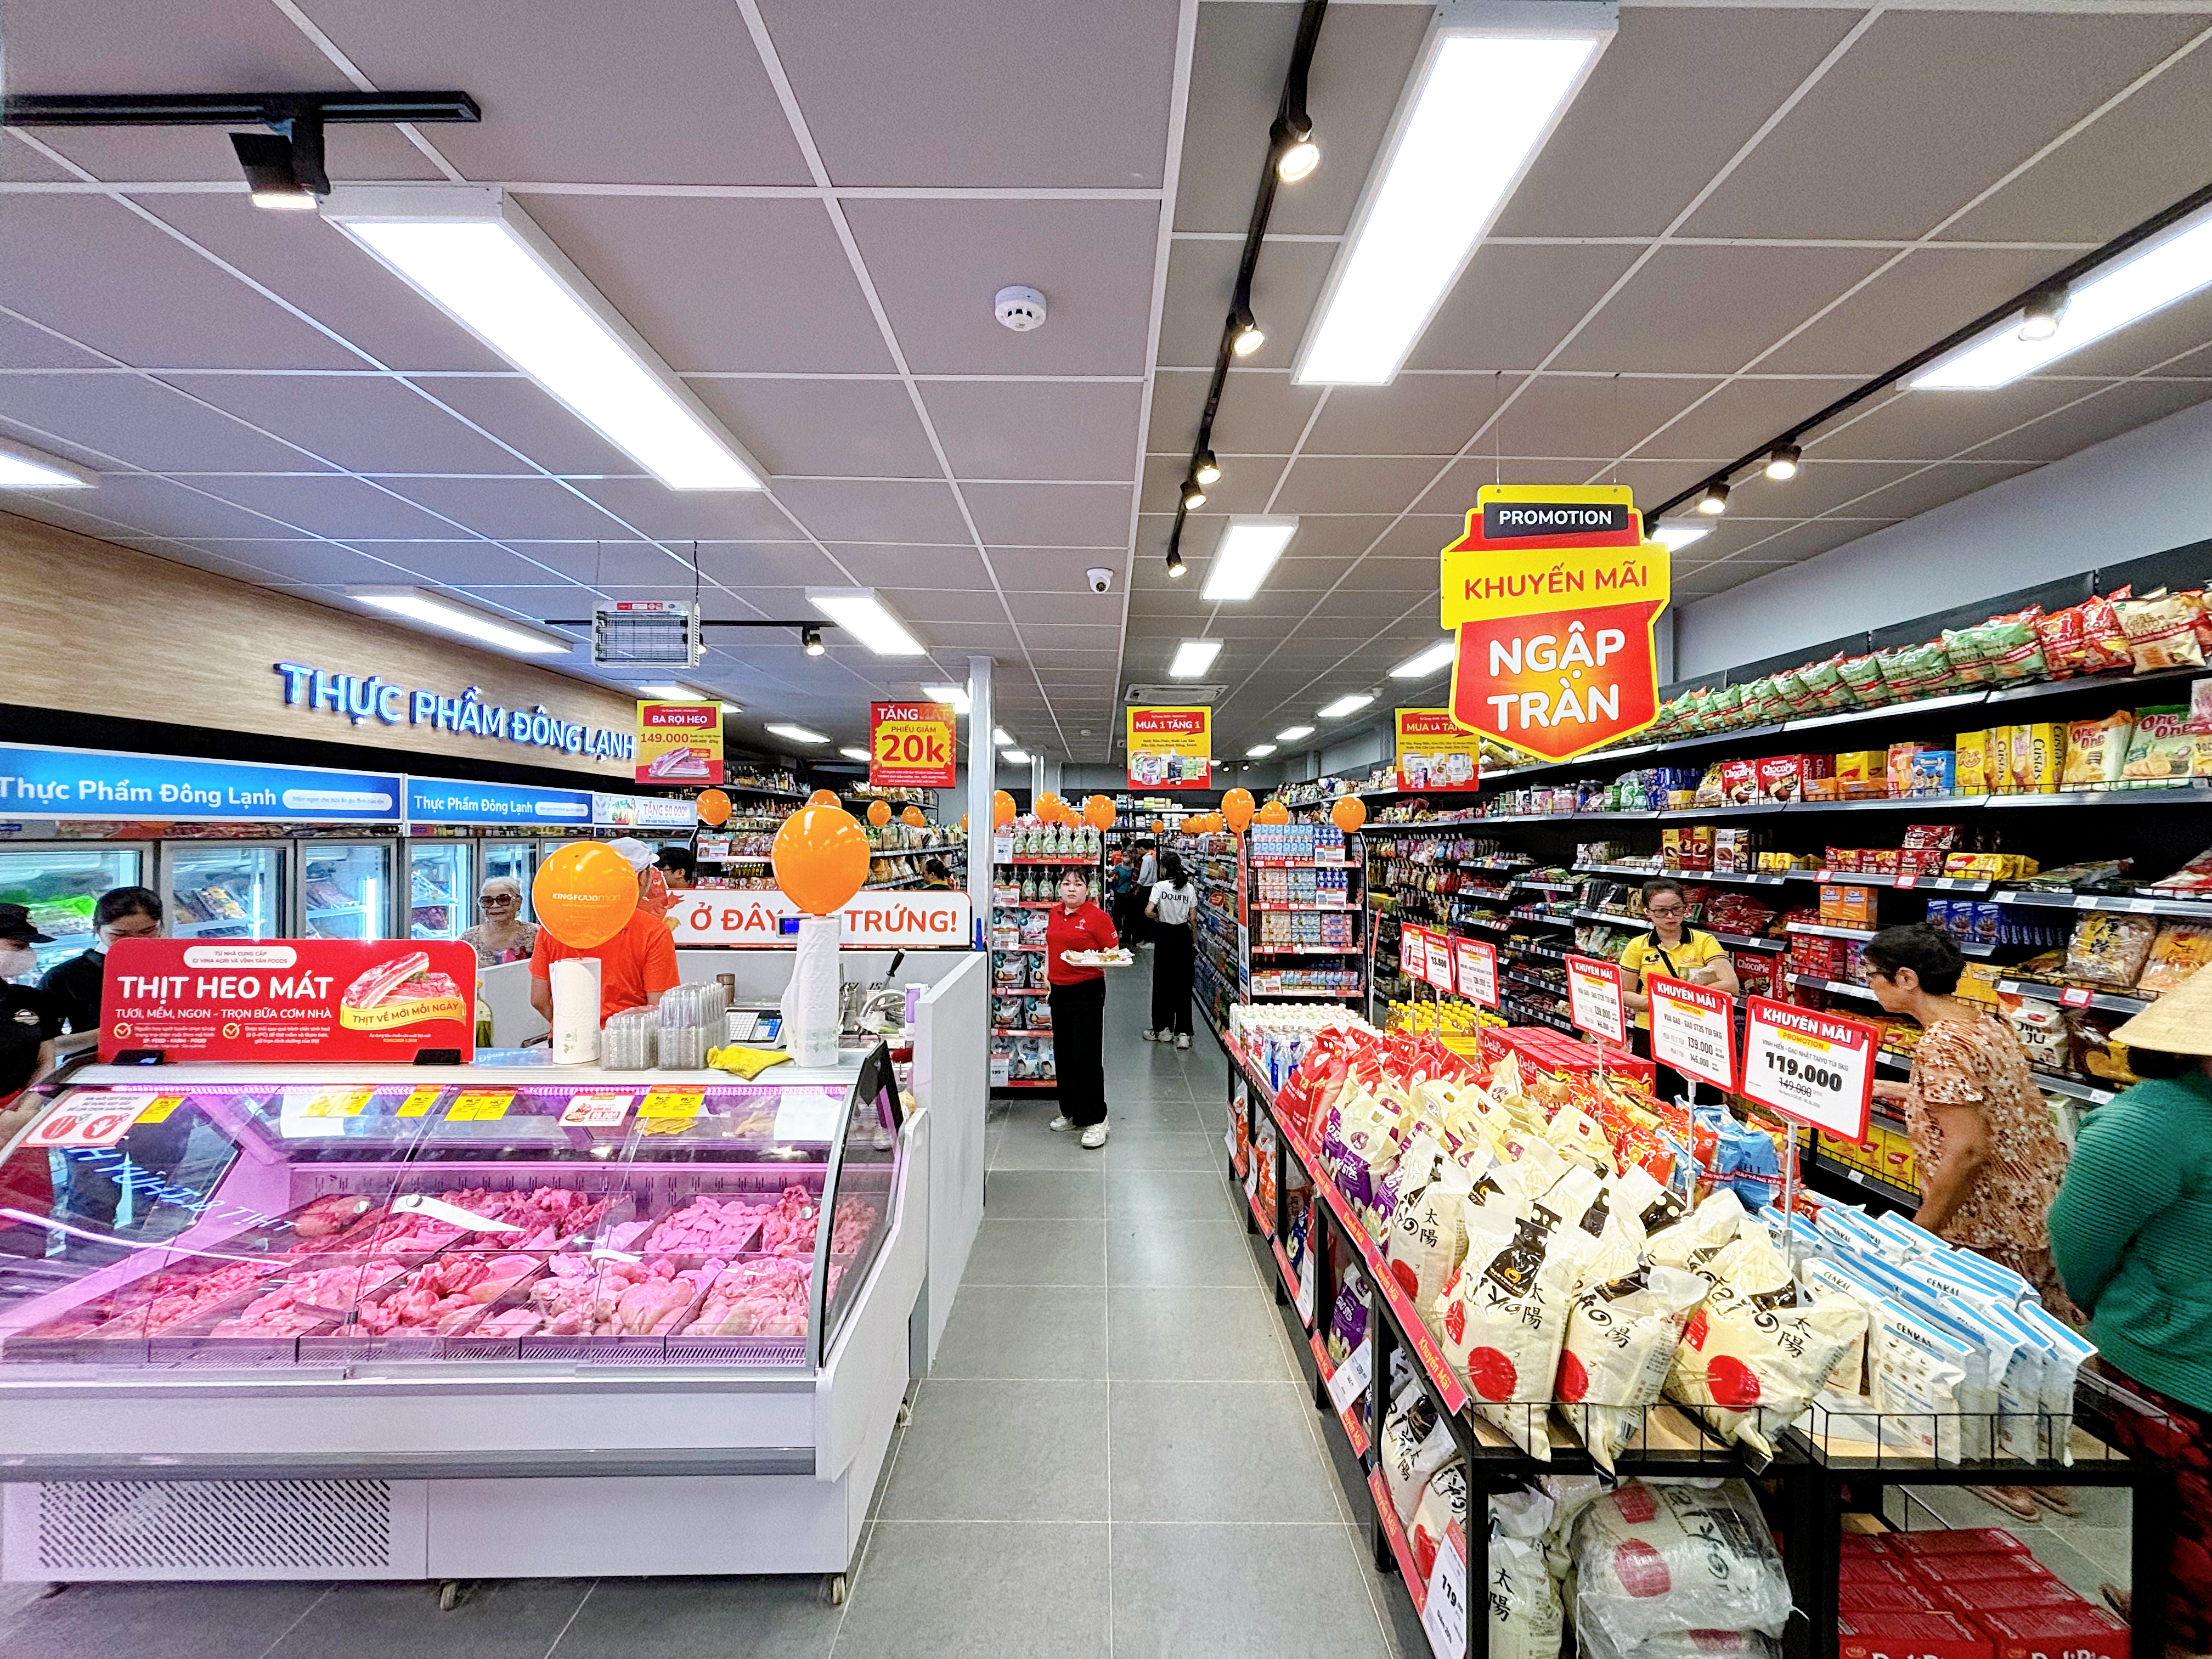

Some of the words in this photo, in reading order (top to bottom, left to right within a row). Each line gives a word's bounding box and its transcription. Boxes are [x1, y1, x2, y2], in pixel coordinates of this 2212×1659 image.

[1499, 510, 1612, 526] PROMOTION
[1465, 562, 1584, 600] KHUYẾN
[1595, 560, 1647, 591] MÃI
[1489, 620, 1625, 679] NGẬP
[273, 663, 404, 725] THỰC
[410, 686, 506, 737] PHẨM
[508, 704, 583, 752] ĐÔNG
[583, 726, 636, 762] LẠNH
[1487, 676, 1620, 731] TRÀN
[652, 715, 666, 724] BA
[668, 715, 685, 725] RỌI
[687, 715, 708, 724] HEO
[891, 724, 914, 733] PHIẾU
[916, 725, 936, 733] GIẢM
[1136, 721, 1158, 729] MUA
[1166, 719, 1193, 731] TẶNG
[1195, 720, 1200, 729] 1
[1407, 723, 1429, 731] MUA
[2141, 714, 2178, 732] One
[640, 733, 689, 743] 149.000
[882, 734, 944, 763] 20k
[1997, 740, 2006, 781] Custas
[2033, 738, 2045, 780] Custas
[1724, 766, 1756, 778] ChocoPie
[1762, 764, 1797, 776] ChocoPie
[0, 776, 70, 805] Thực
[78, 779, 153, 802] Phẩm
[159, 783, 222, 809] Đông
[228, 787, 276, 809] Lạnh
[414, 794, 444, 814] Thực
[447, 795, 478, 812] Phẩm
[482, 798, 509, 814] Đông
[510, 800, 533, 816] Lạnh
[1161, 891, 1189, 905] Downy
[690, 901, 713, 931] Ở
[720, 902, 783, 932] ĐÂY
[844, 903, 957, 933] TRỨNG!
[1575, 961, 1600, 977] KHUYẾN
[1600, 967, 1613, 980] MÃI
[1736, 958, 1770, 973] ChocoPie
[117, 976, 189, 1005] THỊT
[196, 976, 260, 999] HEO
[269, 969, 334, 999] MÁT
[1657, 981, 1695, 1003] KHUYẾN
[1696, 992, 1716, 1009] MÃI
[115, 1007, 144, 1019] TƯƠI,
[177, 1009, 211, 1018] NGON
[221, 1009, 252, 1020] TRỌN
[254, 1007, 278, 1019] BỮA
[280, 1007, 306, 1018] CƠM
[307, 1007, 332, 1019] NHÀ
[352, 1015, 375, 1025] THỊT
[1763, 1007, 1819, 1034] KHUYẾN
[1821, 1023, 1852, 1043] MÃI
[1483, 1036, 1506, 1057] DeliPie
[1688, 1036, 1713, 1056] 139.000
[1782, 1031, 1824, 1050] PROMOTION
[1519, 1053, 1537, 1073] DeliP
[1765, 1051, 1843, 1092] 119.000
[1344, 1167, 1358, 1182] ST25
[1355, 1229, 1365, 1245] Mãi
[1419, 1208, 1440, 1248] 太陽
[1374, 1261, 1392, 1290] Khuyến
[1388, 1283, 1399, 1303] Mãi
[1522, 1282, 1546, 1329] 太陽
[1777, 1315, 1813, 1358] 太陽
[1417, 1337, 1440, 1376] Khuyến
[1435, 1367, 1452, 1392] Mãi
[1353, 1429, 1364, 1448] Mãi
[1489, 1568, 1514, 1622] 太陽
